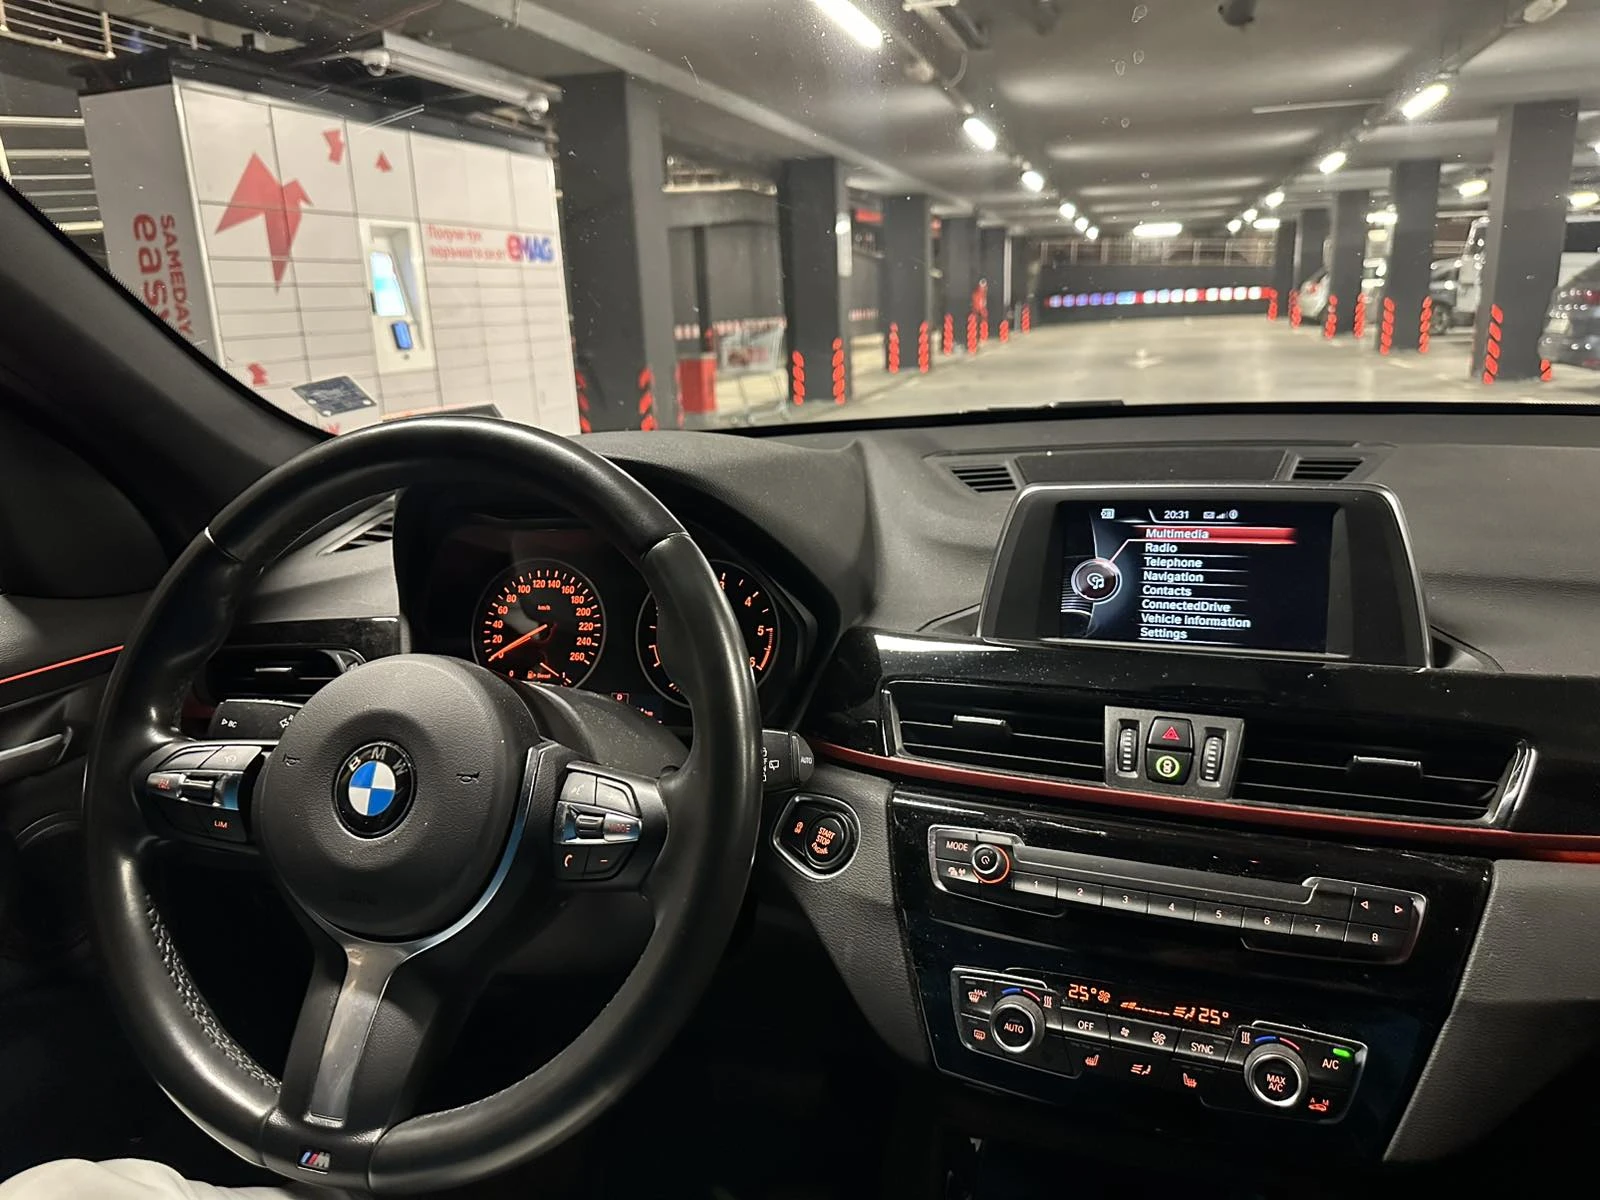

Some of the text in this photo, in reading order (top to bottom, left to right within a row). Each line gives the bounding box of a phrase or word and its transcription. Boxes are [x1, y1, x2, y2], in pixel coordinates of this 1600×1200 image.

[161, 214, 192, 334] SAMEDAY
[1163, 510, 1190, 519] 20:31
[1145, 528, 1210, 539] Multimedia
[1145, 542, 1178, 553] Radio
[1143, 556, 1203, 568] Telephone
[1143, 570, 1204, 583] Navigation
[517, 585, 531, 594] 100
[533, 580, 546, 588] 120
[547, 580, 561, 588] 140
[561, 585, 575, 594] 160
[1142, 584, 1193, 596] Contacts
[506, 594, 517, 603] 80
[570, 595, 584, 604] 180
[744, 596, 752, 607] 4
[497, 606, 508, 615] 60
[1141, 598, 1232, 613] ConnectedDrive
[575, 607, 591, 616] 200
[1141, 612, 1183, 624] Vehicle
[492, 620, 503, 629] 40
[578, 622, 594, 631] 220
[757, 625, 765, 636] 5
[1140, 627, 1188, 640] Settings
[492, 634, 503, 643] 20
[576, 637, 592, 646] 240
[569, 652, 585, 661] 260
[347, 746, 408, 776] BMW
[800, 756, 813, 765] AUTO
[818, 827, 836, 840] START
[816, 834, 831, 846] STOP
[945, 840, 969, 852] MODE
[1077, 887, 1084, 897] 2
[1122, 895, 1129, 904] 3
[1168, 902, 1176, 912] 4
[1215, 909, 1222, 919] 5
[1263, 916, 1271, 926] 6
[1314, 924, 1321, 933] 7
[1371, 932, 1379, 942] 8
[1003, 1022, 1025, 1034] AUTO
[1077, 1020, 1095, 1031] OFF
[1191, 1042, 1214, 1055] SYNC
[1322, 1058, 1340, 1071] A/C
[1266, 1073, 1287, 1085] MAX
[1268, 1082, 1284, 1092] A/C
